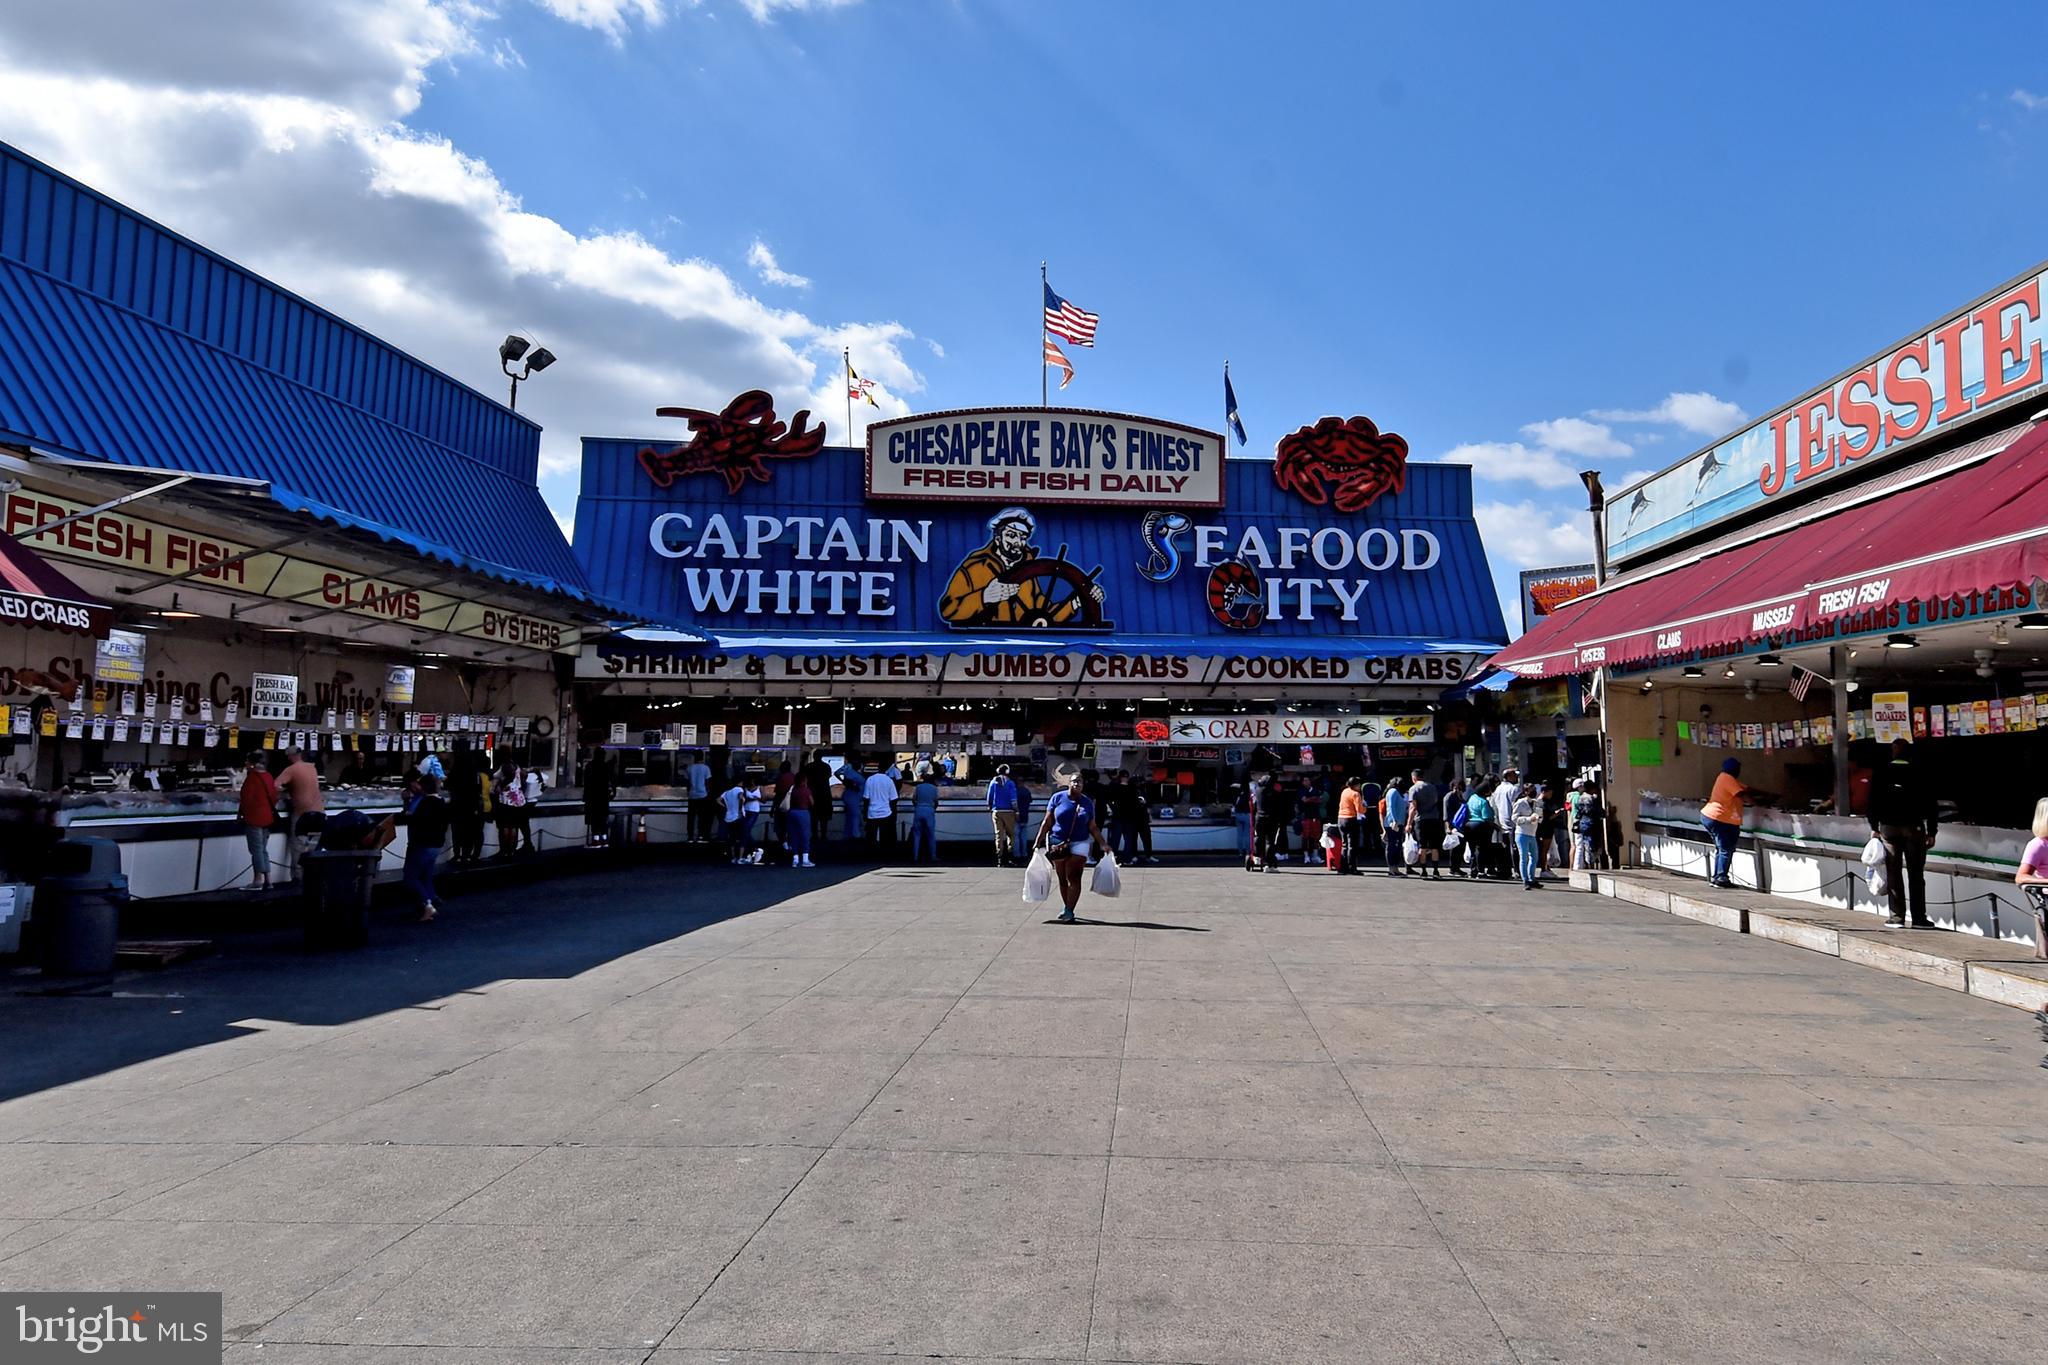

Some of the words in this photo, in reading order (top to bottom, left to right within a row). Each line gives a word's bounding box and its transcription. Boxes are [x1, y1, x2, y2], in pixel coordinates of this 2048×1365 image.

[1760, 277, 2044, 496] JESSIE
[888, 420, 1040, 467] CHESAPEAKE
[1050, 421, 1116, 470] BAY'S
[1126, 429, 1204, 472] FINEST
[903, 468, 1010, 489] FRESH
[1020, 472, 1090, 491] FISH
[1100, 474, 1189, 493] DAILY
[6, 494, 152, 564] FRESH
[166, 534, 244, 584] FISH
[649, 512, 932, 563] CAPTAIN
[322, 573, 421, 621] CLAMS
[683, 567, 895, 616] WHITE
[1818, 587, 1859, 615] FRESH
[1857, 579, 1890, 603] FISH
[30, 600, 90, 629] CRABS
[1753, 604, 1796, 632] MUSSELS
[483, 611, 561, 647] OYSTERS
[1657, 631, 1682, 650] CLAMS
[109, 643, 132, 653] FREE
[603, 654, 728, 675] SHRIMP
[745, 655, 765, 676] &
[785, 654, 929, 677] LOBSTER
[964, 654, 1071, 680] JUMBO
[1086, 655, 1189, 680] CRABS
[1227, 656, 1350, 680] COOKED
[1364, 657, 1463, 681] CRABS
[254, 690, 294, 703] CROAKERS
[256, 678, 278, 690] FRESH
[280, 680, 294, 690] BAY
[1208, 718, 1270, 739] CRAB
[1281, 718, 1342, 739] SALE
